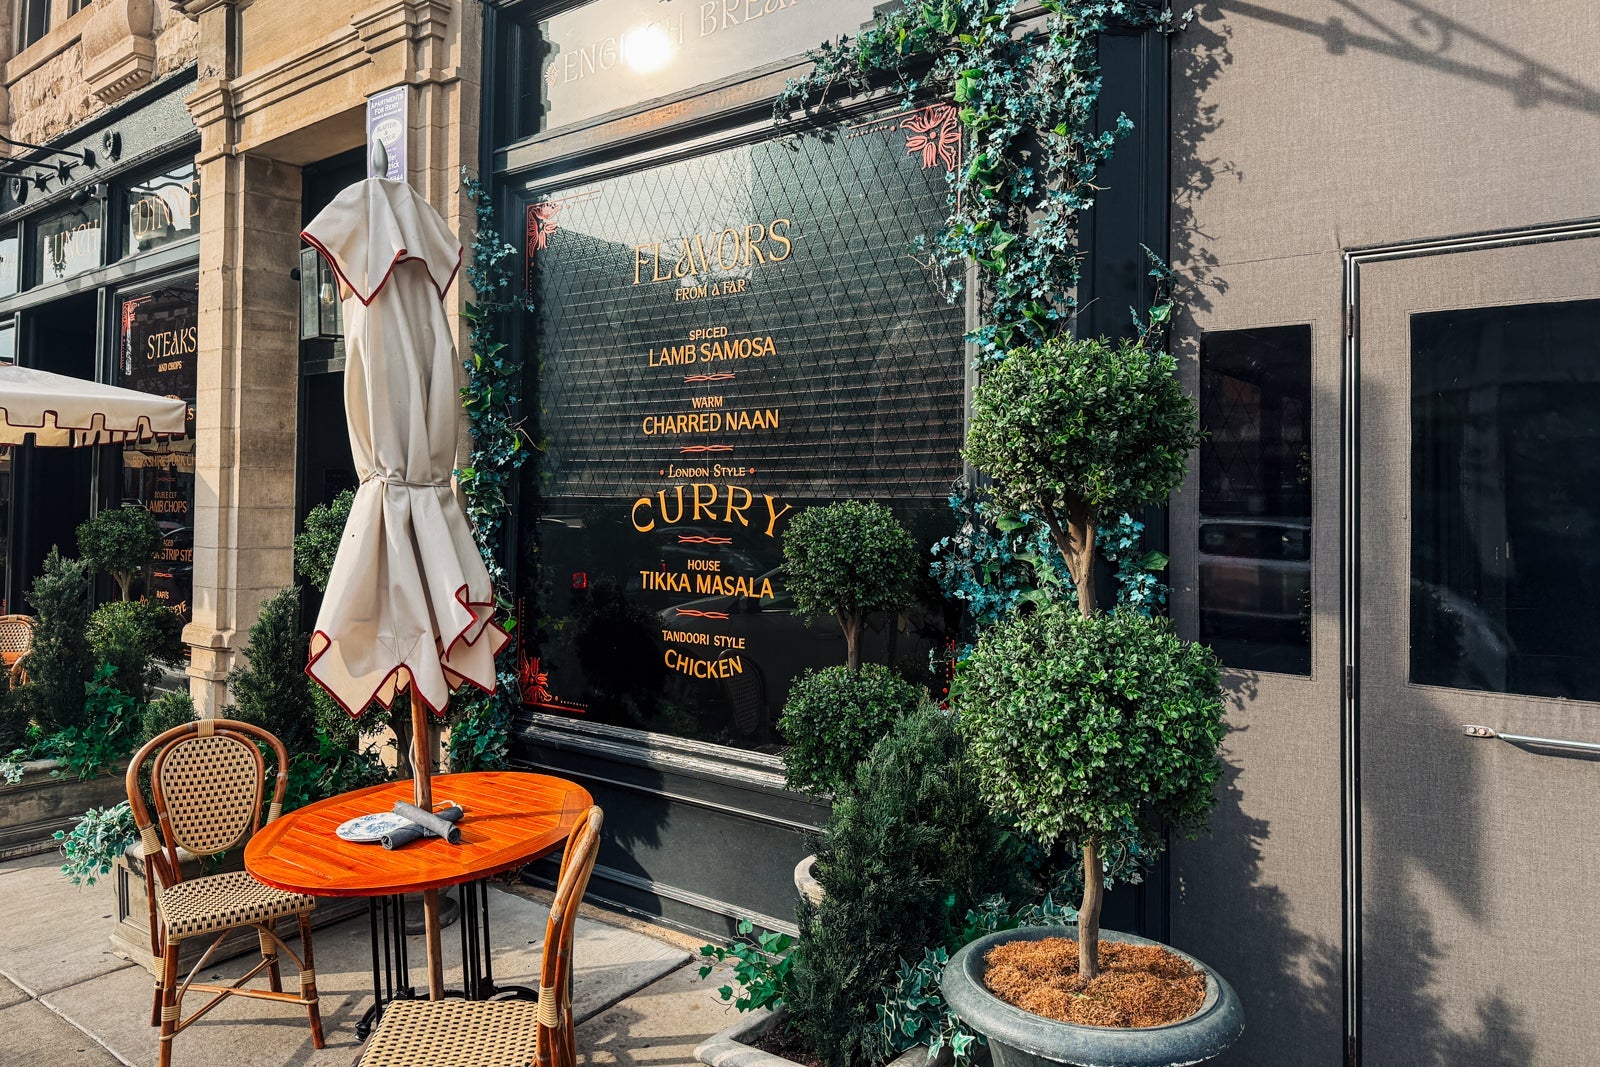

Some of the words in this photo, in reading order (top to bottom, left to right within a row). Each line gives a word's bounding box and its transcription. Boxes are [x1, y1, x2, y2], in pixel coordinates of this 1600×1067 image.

[374, 106, 384, 116] FOR
[385, 102, 399, 112] RENT
[45, 219, 98, 268] LUNCH
[633, 218, 791, 285] FLAVORS
[675, 286, 707, 301] FROM
[711, 283, 720, 296] A
[723, 278, 746, 293] FAR
[147, 326, 197, 360] STEAKS
[689, 326, 728, 341] SPICED
[649, 343, 697, 367] LAMB
[700, 336, 777, 362] SAMOSA
[158, 362, 167, 373] AND
[168, 360, 182, 371] CHOPS
[692, 395, 723, 408] WARM
[642, 413, 721, 435] CHARRED
[726, 409, 779, 431] NAAN
[132, 454, 166, 468] BERKSHIRE
[167, 453, 186, 466] PORK
[154, 490, 168, 499] DOUBLE
[169, 491, 177, 499] CUT
[145, 500, 164, 512] LAMB
[164, 501, 187, 513] CHOPS
[631, 483, 793, 538] CURRY
[161, 549, 179, 561] STRIP
[687, 559, 721, 572] HOUSE
[639, 570, 692, 593] TIKKA
[696, 574, 775, 600] MASALA
[661, 629, 710, 646] TANDOORI
[713, 635, 746, 649] STYLE
[664, 649, 743, 679] CHICKEN
